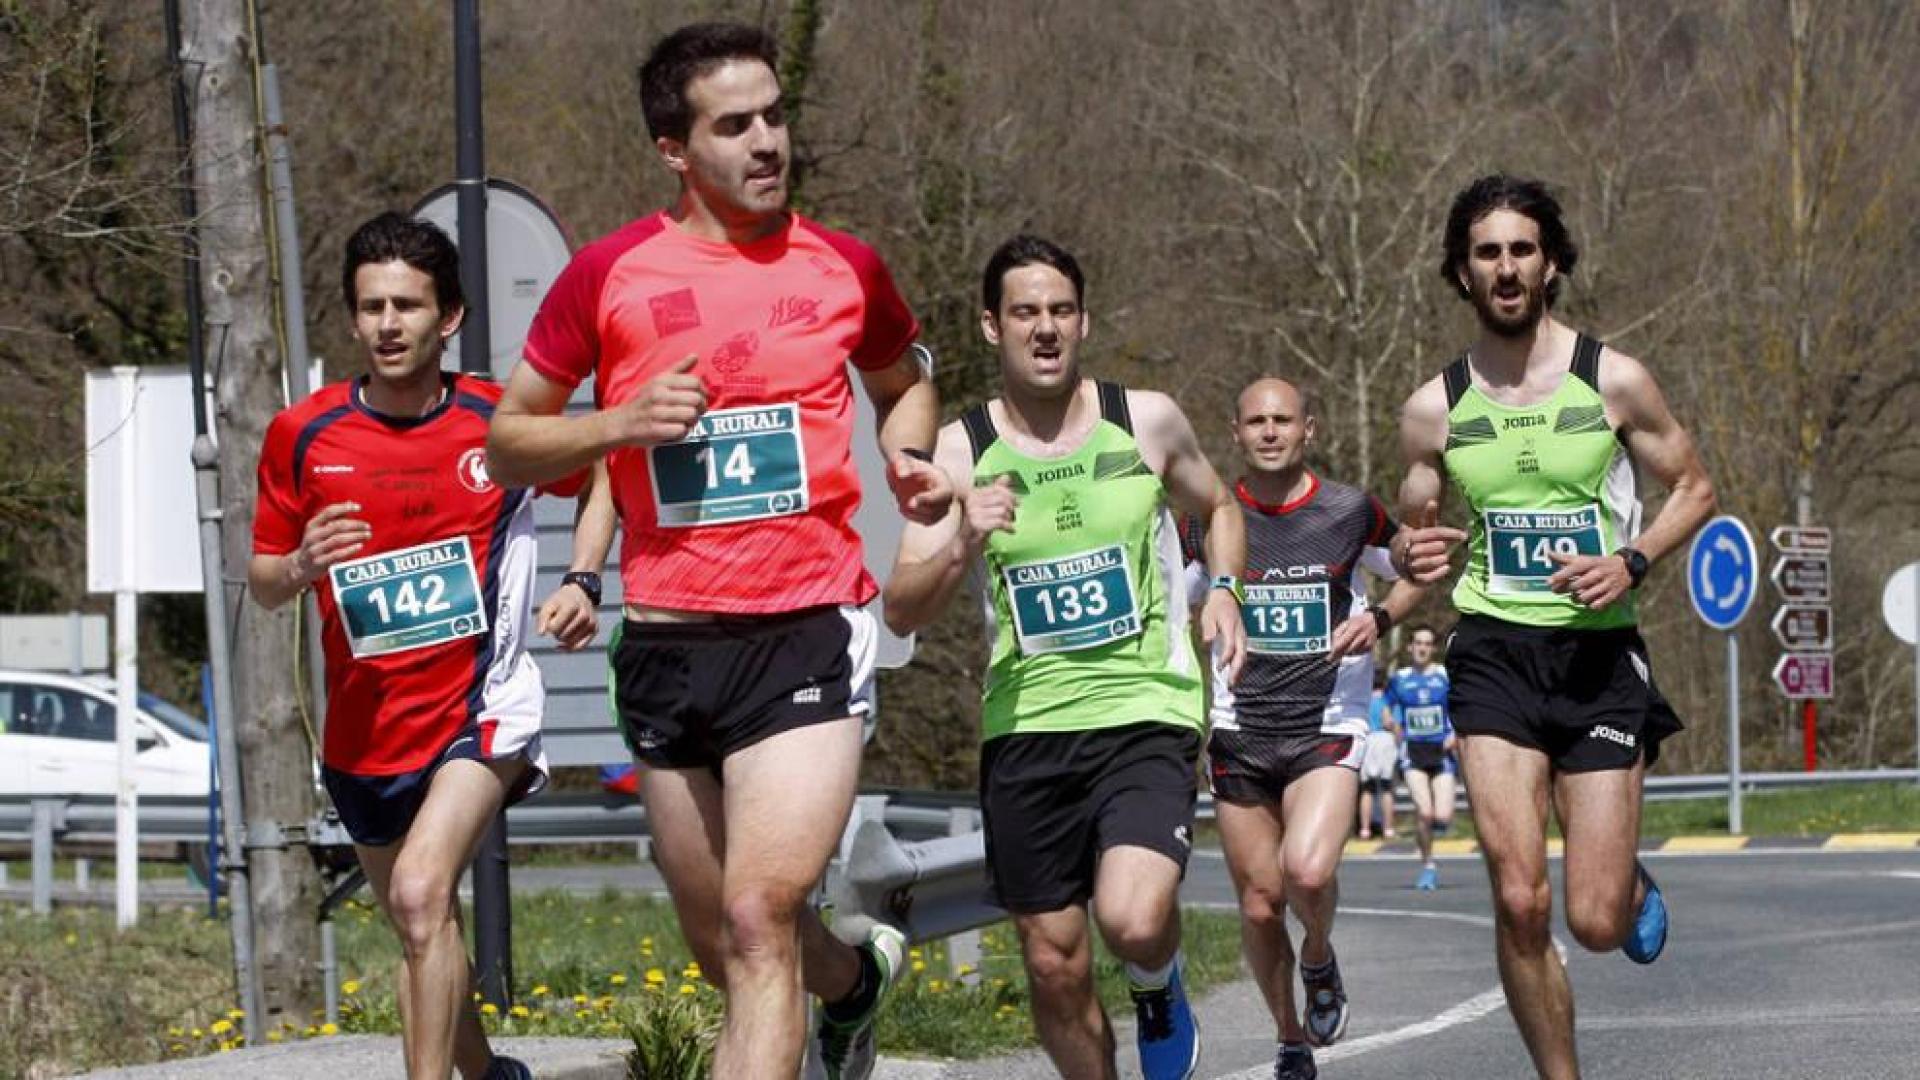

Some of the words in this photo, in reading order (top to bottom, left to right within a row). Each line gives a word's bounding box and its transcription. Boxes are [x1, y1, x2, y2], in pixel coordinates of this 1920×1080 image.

[711, 412, 785, 435] RURAL
[695, 443, 756, 490] 14
[1494, 514, 1531, 529] CAJA
[1535, 511, 1591, 528] RURAL
[346, 562, 390, 582] CAJA
[394, 546, 459, 572] RURAL
[1017, 566, 1055, 583] CAJA
[1057, 552, 1116, 577] RURAL
[367, 574, 451, 624] 142
[1035, 579, 1109, 625] 133
[1274, 588, 1320, 601] RURAL
[1252, 606, 1305, 633] 131
